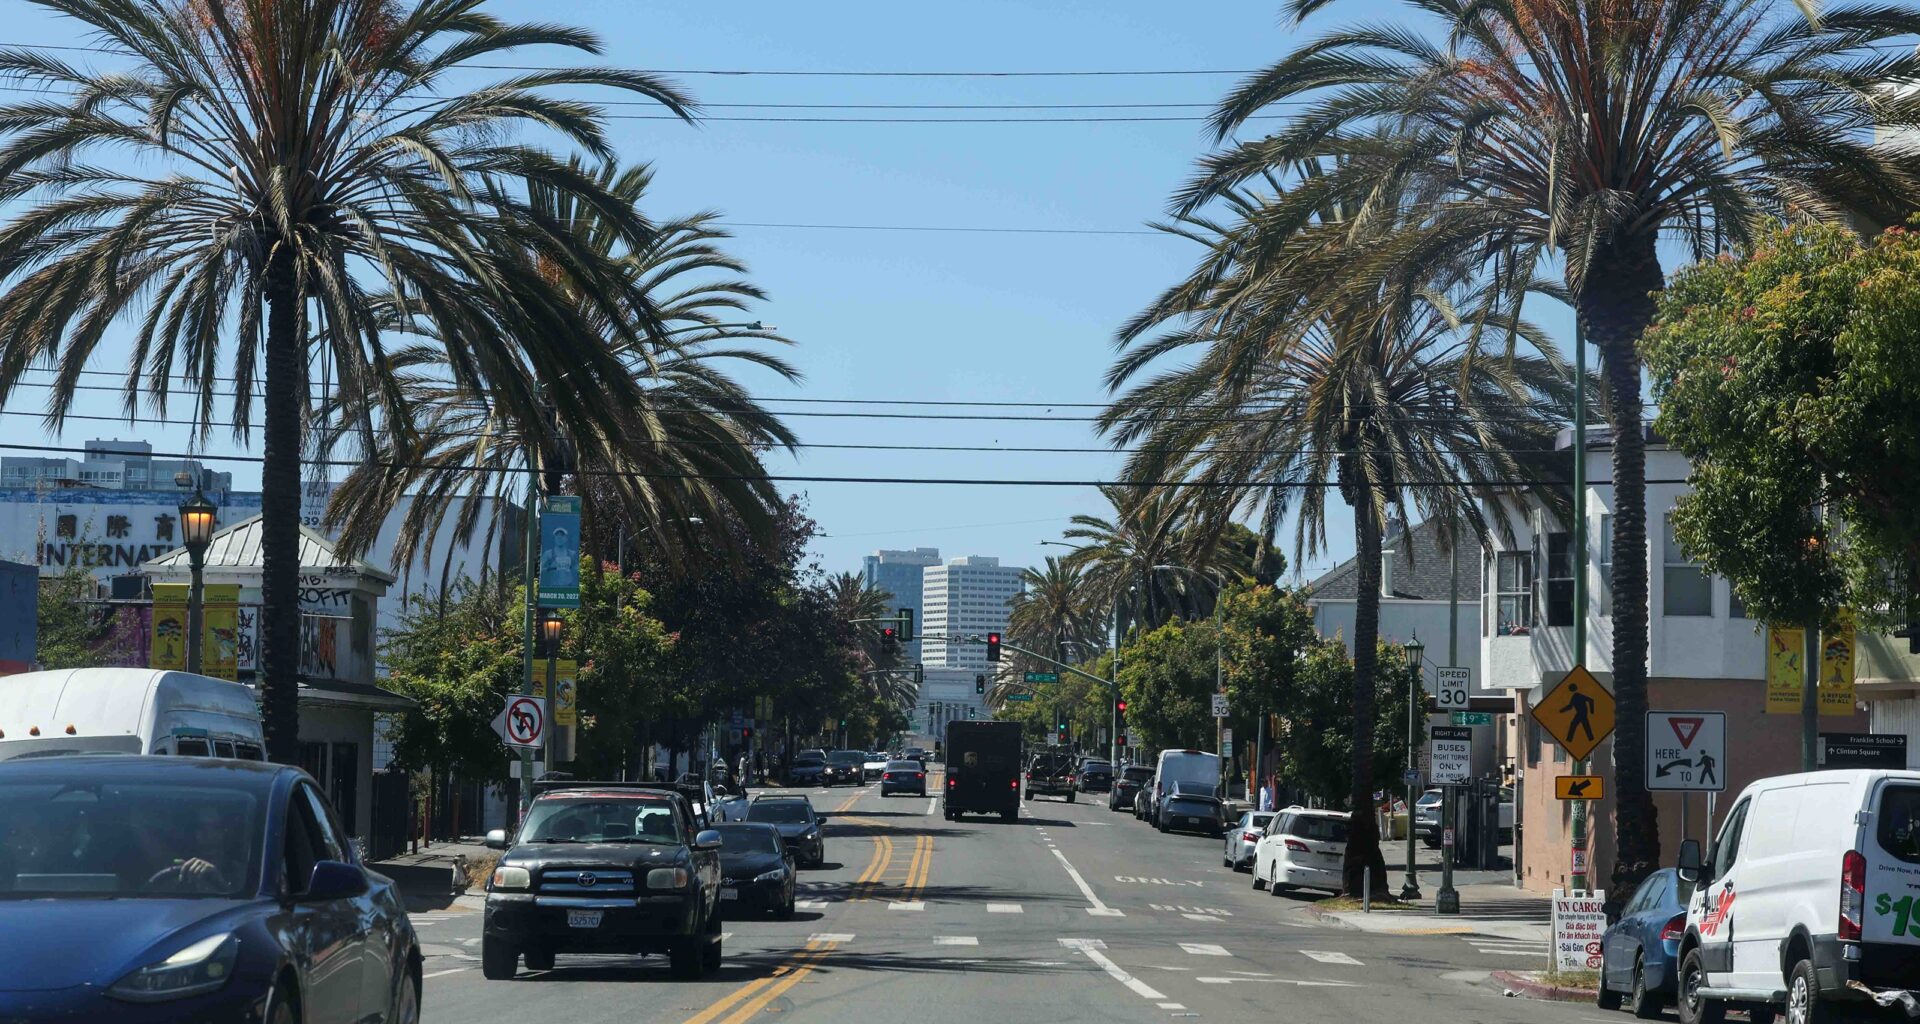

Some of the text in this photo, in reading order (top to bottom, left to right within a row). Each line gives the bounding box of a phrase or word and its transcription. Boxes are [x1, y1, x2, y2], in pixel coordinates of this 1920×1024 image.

[1440, 670, 1468, 678] SPEED
[1440, 689, 1466, 704] 30
[1214, 706, 1228, 715] 30
[1437, 744, 1466, 752] BUSES
[1655, 748, 1681, 759] HERE
[1859, 748, 1881, 756] Square
[1680, 771, 1692, 782] TO
[1879, 864, 1896, 872] Drive
[1896, 866, 1913, 875] Now,
[1113, 875, 1203, 887] ONLY
[1557, 901, 1603, 913] VN CARGO
